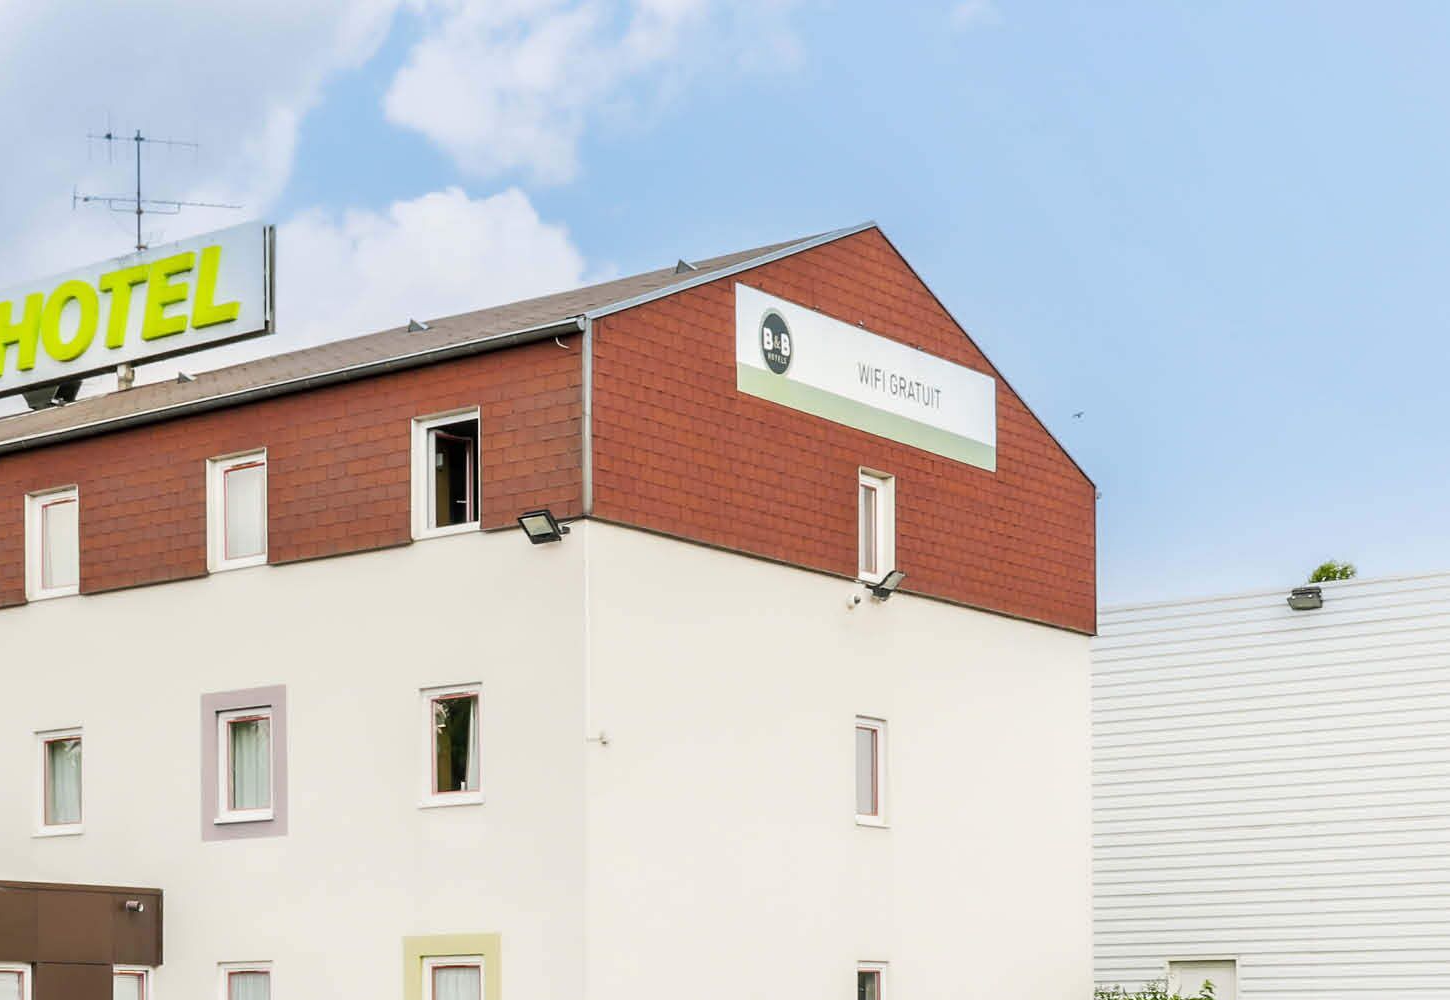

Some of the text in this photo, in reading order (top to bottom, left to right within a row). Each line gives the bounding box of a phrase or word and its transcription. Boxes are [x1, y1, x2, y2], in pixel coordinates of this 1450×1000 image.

[763, 327, 790, 357] B&B
[857, 361, 941, 409] WIFI GRATUIT
